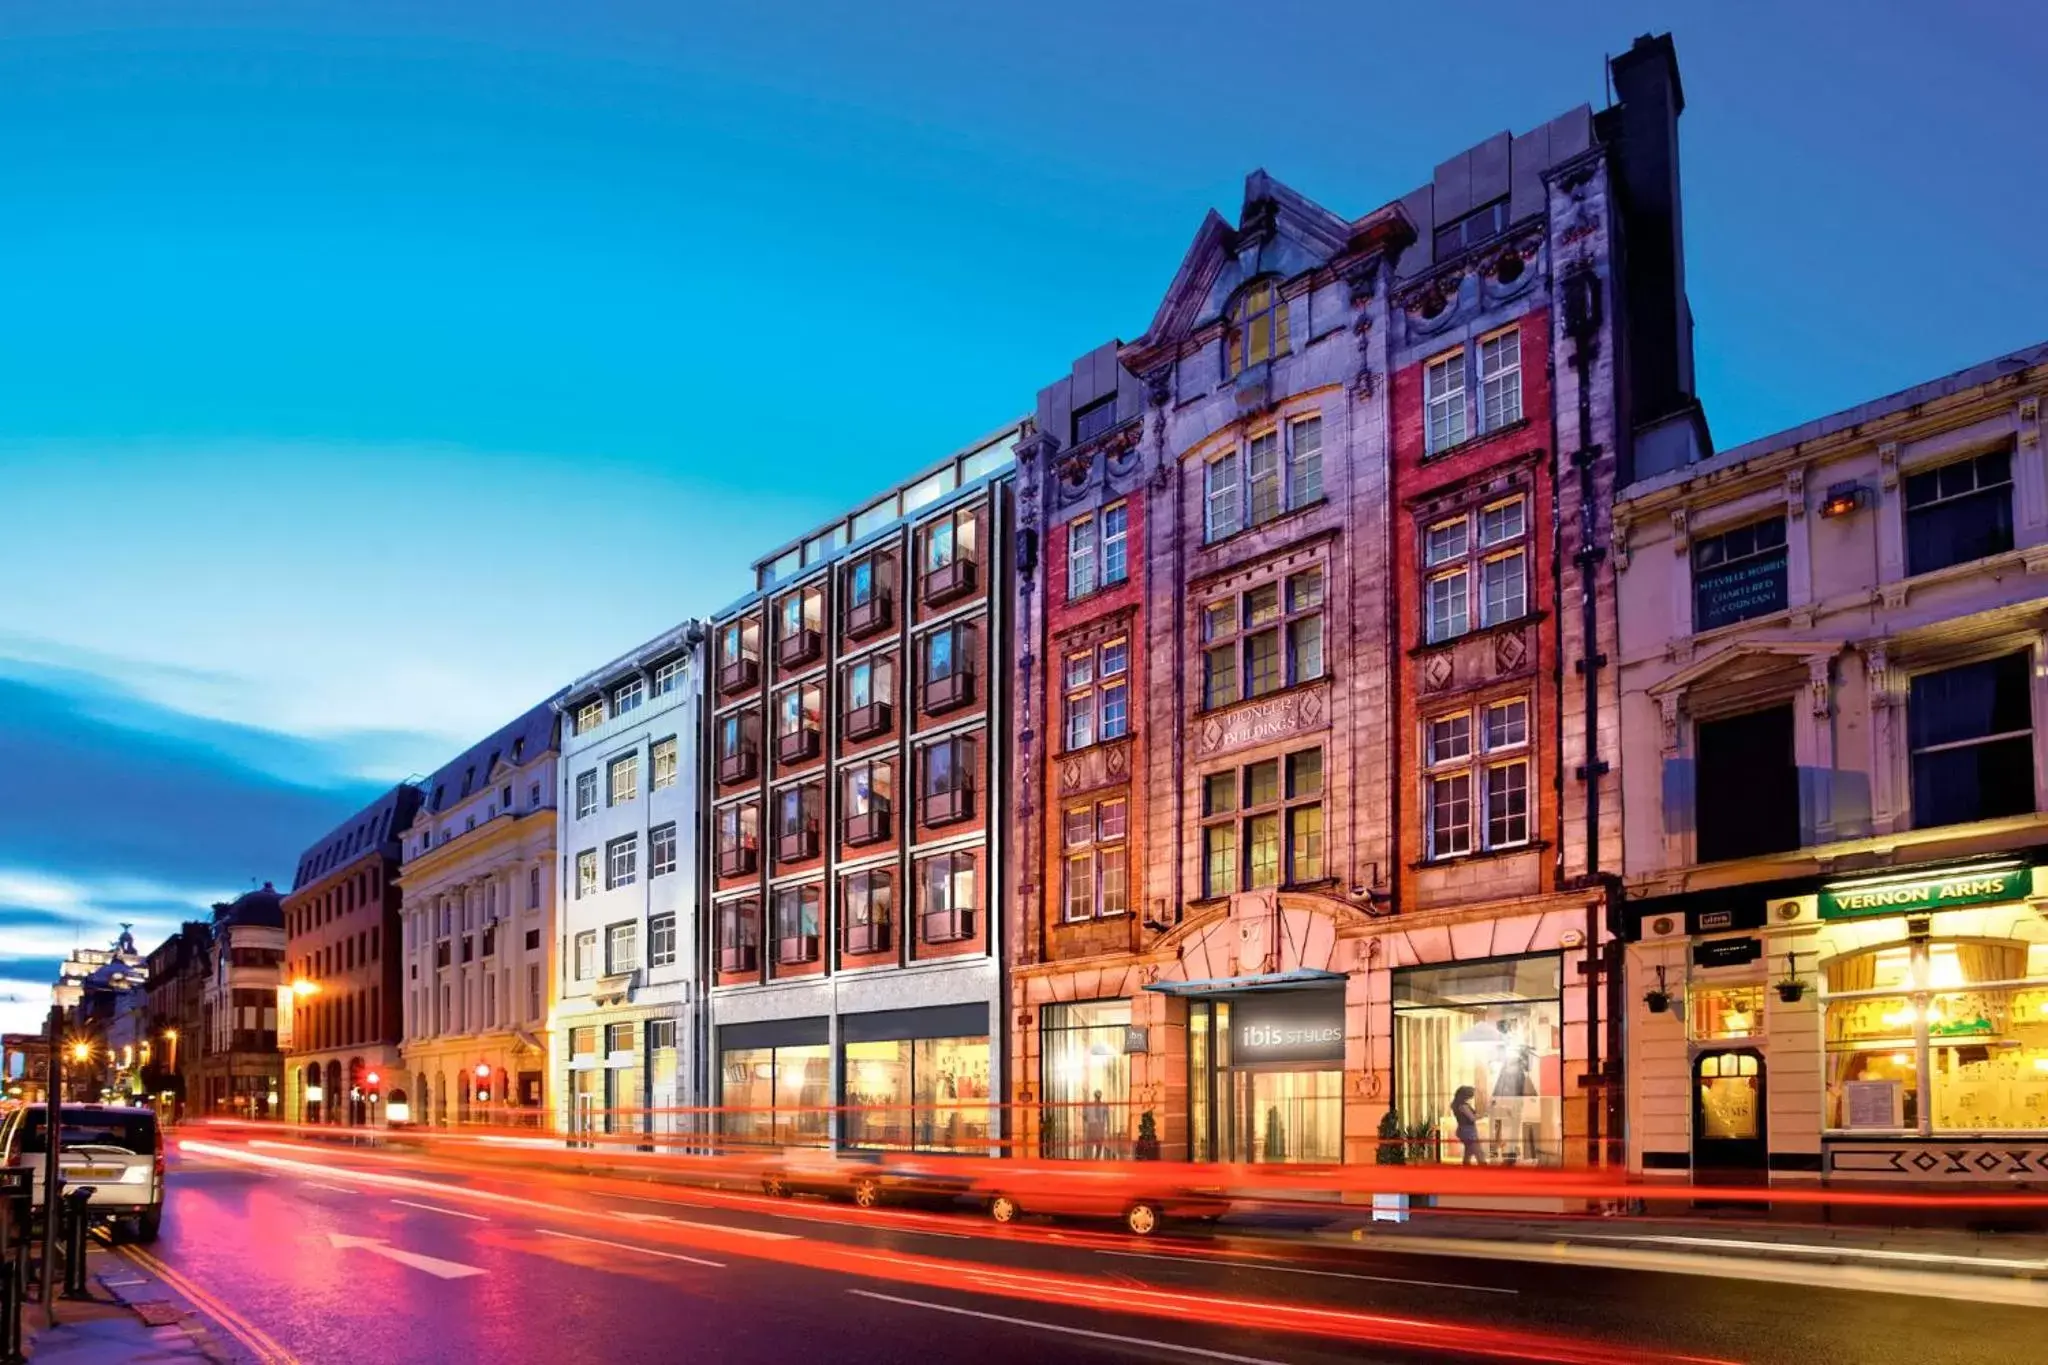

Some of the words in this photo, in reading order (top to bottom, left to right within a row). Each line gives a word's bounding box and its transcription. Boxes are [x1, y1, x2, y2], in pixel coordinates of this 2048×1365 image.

[1227, 699, 1292, 725] PIONEER
[1224, 718, 1296, 744] BUILDINGS
[1836, 888, 1930, 910] VERNON
[1939, 879, 2005, 899] ARMS
[1243, 1025, 1282, 1047] ibis
